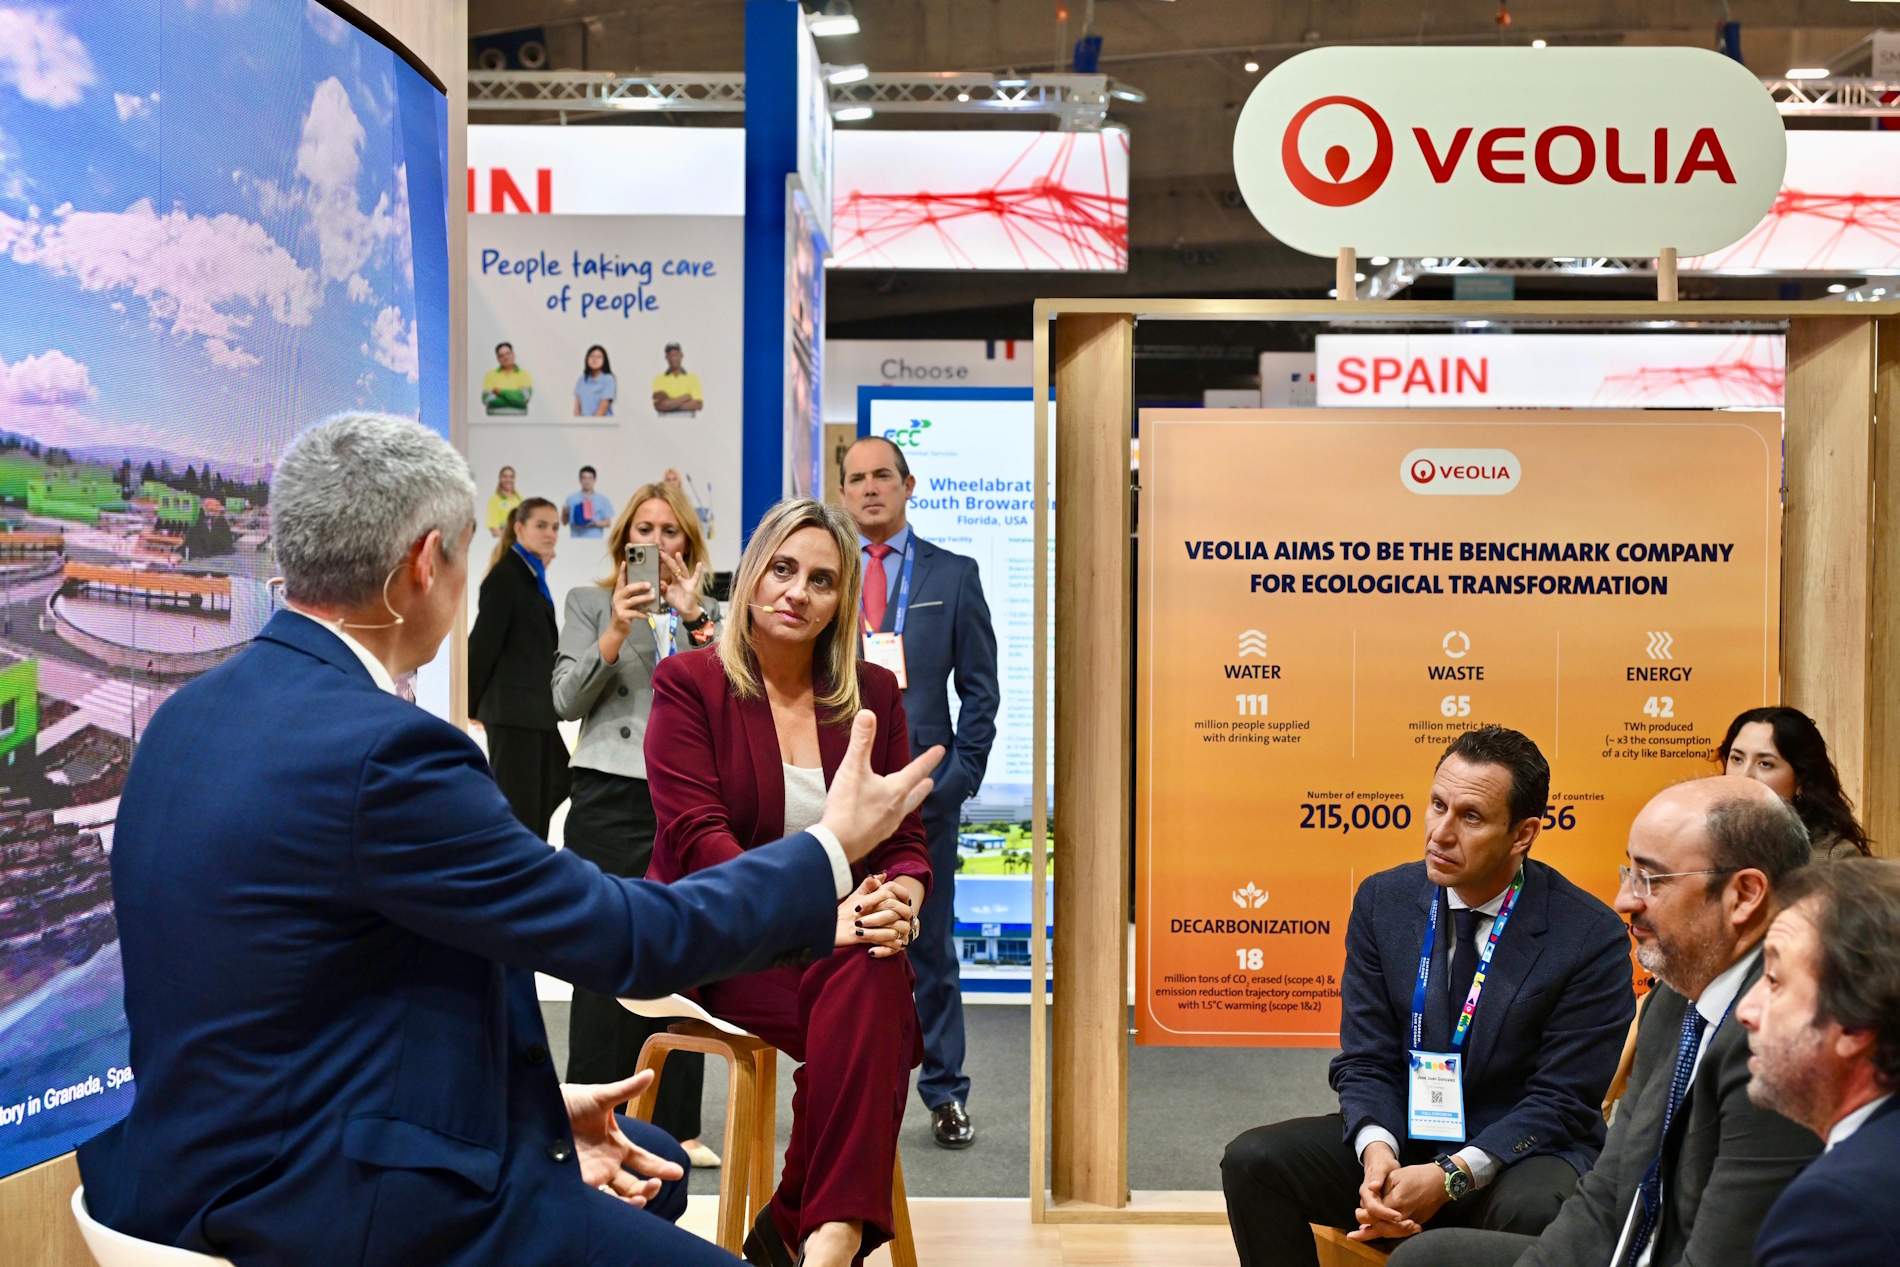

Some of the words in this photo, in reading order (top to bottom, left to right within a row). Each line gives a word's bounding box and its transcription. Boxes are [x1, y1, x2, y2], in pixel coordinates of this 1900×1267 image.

[1412, 125, 1737, 185] VEOLIA
[482, 249, 562, 283] People
[572, 250, 652, 285] taking
[662, 259, 717, 277] care
[546, 284, 571, 312] of
[581, 286, 659, 318] people
[881, 357, 969, 380] Choose
[1336, 357, 1488, 394] SPAIN
[1440, 466, 1510, 479] VEOLIA
[929, 477, 1051, 492] Wheelabrat
[909, 496, 959, 509] South
[957, 515, 1001, 526] Florida,
[1004, 515, 1028, 525] USA
[1185, 541, 1269, 560] VEOLIA
[1274, 541, 1335, 561] AIMS
[1340, 541, 1371, 561] TO
[1377, 542, 1404, 561] BE
[1409, 542, 1453, 561] THE
[1460, 542, 1610, 562] BENCHMARK
[1616, 543, 1734, 562] COMPANY
[1250, 574, 1295, 593] FOR
[1302, 575, 1444, 594] ECOLOGICAL
[1449, 575, 1668, 595] TRANSFORMATION
[1224, 665, 1281, 679] WATER
[1428, 666, 1484, 680] WASTE
[1626, 667, 1692, 681] ENERGY
[1236, 694, 1268, 715] 111
[1440, 695, 1471, 717] 65
[1643, 696, 1674, 718] 42
[1194, 720, 1229, 729] million
[1232, 720, 1265, 731] people
[1268, 720, 1310, 731] supplied
[1408, 721, 1443, 730] million
[1446, 721, 1478, 730] metric
[1624, 722, 1646, 732] TWh
[1648, 722, 1693, 733] produced
[1203, 733, 1225, 742] with
[1228, 733, 1269, 745] drinking
[1272, 734, 1301, 743] water
[1414, 734, 1425, 744] of
[1428, 735, 1460, 744] treate
[1617, 736, 1628, 744] x3
[1631, 736, 1647, 744] the
[1648, 736, 1711, 747] consumption
[1602, 748, 1613, 758] of
[1614, 750, 1620, 758] a
[1622, 749, 1639, 760] city
[1641, 749, 1658, 758] like
[1307, 791, 1342, 799] Number
[1345, 791, 1354, 799] of
[1357, 791, 1404, 801] employees
[1552, 792, 1561, 800] of
[1563, 792, 1605, 801] countries
[1300, 803, 1411, 834] 215,000
[1542, 805, 1576, 830] 56
[1171, 919, 1330, 934] DECARBONIZATION
[1236, 948, 1264, 970] 18
[1164, 974, 1196, 983] million
[1199, 975, 1219, 983] tons
[1221, 974, 1232, 983] of
[1251, 975, 1282, 984] erased
[1284, 975, 1313, 986] (scope
[1315, 975, 1325, 985] 4)
[1327, 975, 1335, 984] &
[1155, 987, 1197, 996] emission
[1200, 987, 1243, 996] reduction
[1245, 987, 1290, 999] trajectory
[1178, 1001, 1199, 1009] with
[1201, 1001, 1222, 1010] 1.5°C
[1224, 1001, 1267, 1012] warming
[1268, 1001, 1298, 1012] (scope
[1301, 1001, 1321, 1012] 1&2)
[28, 1096, 41, 1116] in
[44, 1075, 104, 1109] Granada,
